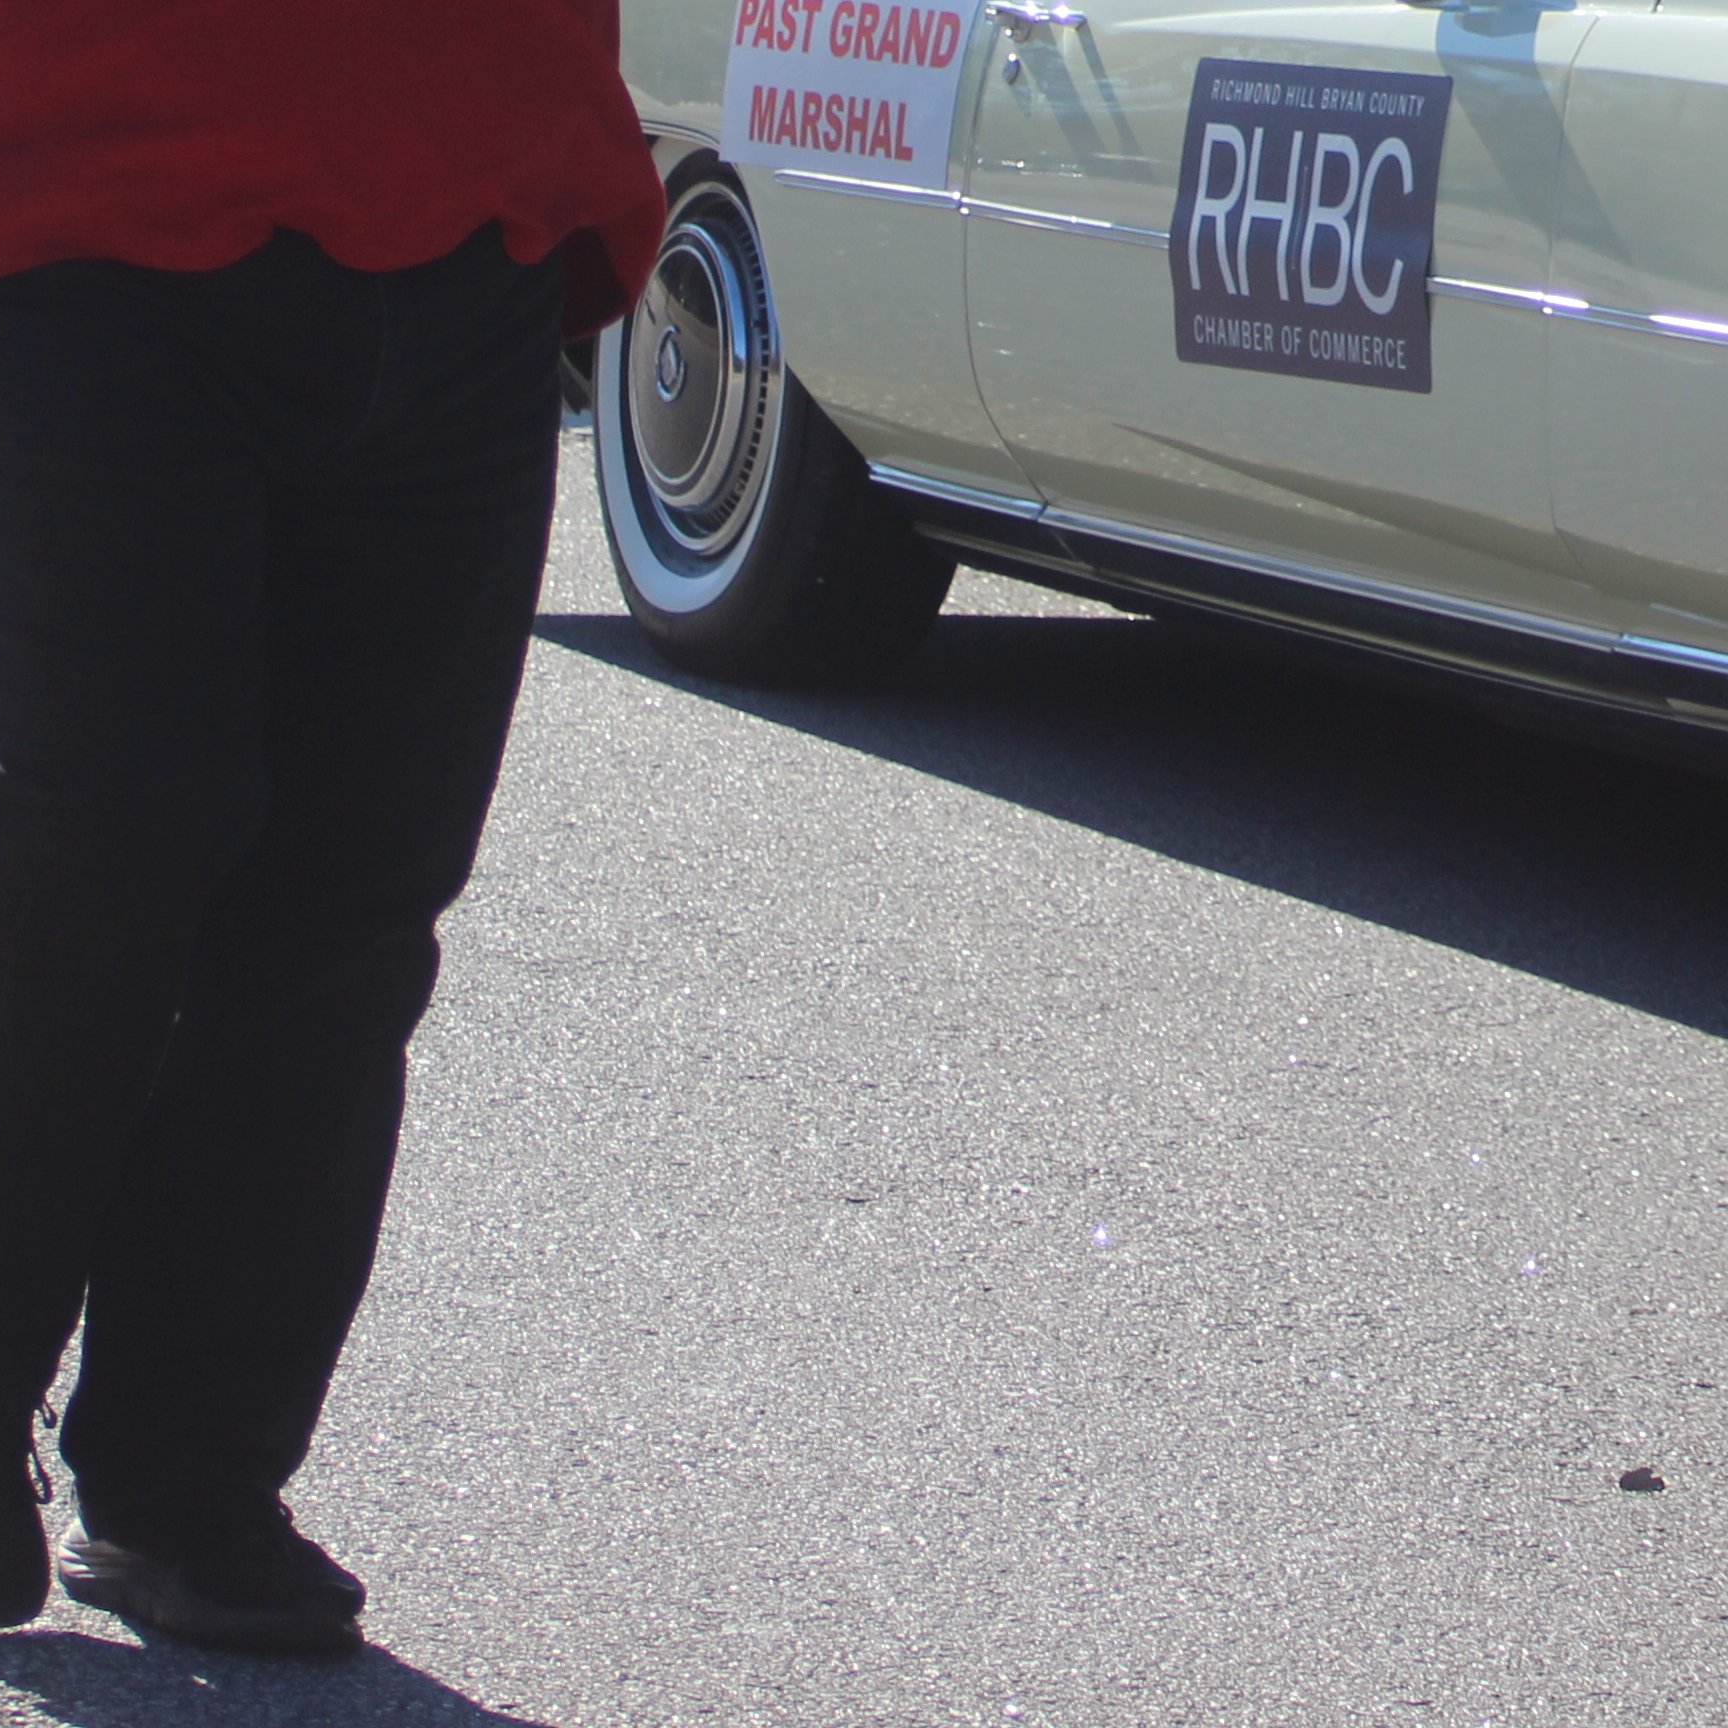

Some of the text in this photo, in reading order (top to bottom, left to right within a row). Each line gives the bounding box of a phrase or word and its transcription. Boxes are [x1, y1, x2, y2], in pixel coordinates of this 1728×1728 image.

[828, 0, 962, 70] GRAND
[748, 84, 915, 162] MARSHAL
[1210, 78, 1425, 118] RICHMOND HILL BRYAN COUNTY
[1187, 121, 1414, 316] RHBC
[1193, 313, 1408, 371] CHAMBER OF COMMERCE
